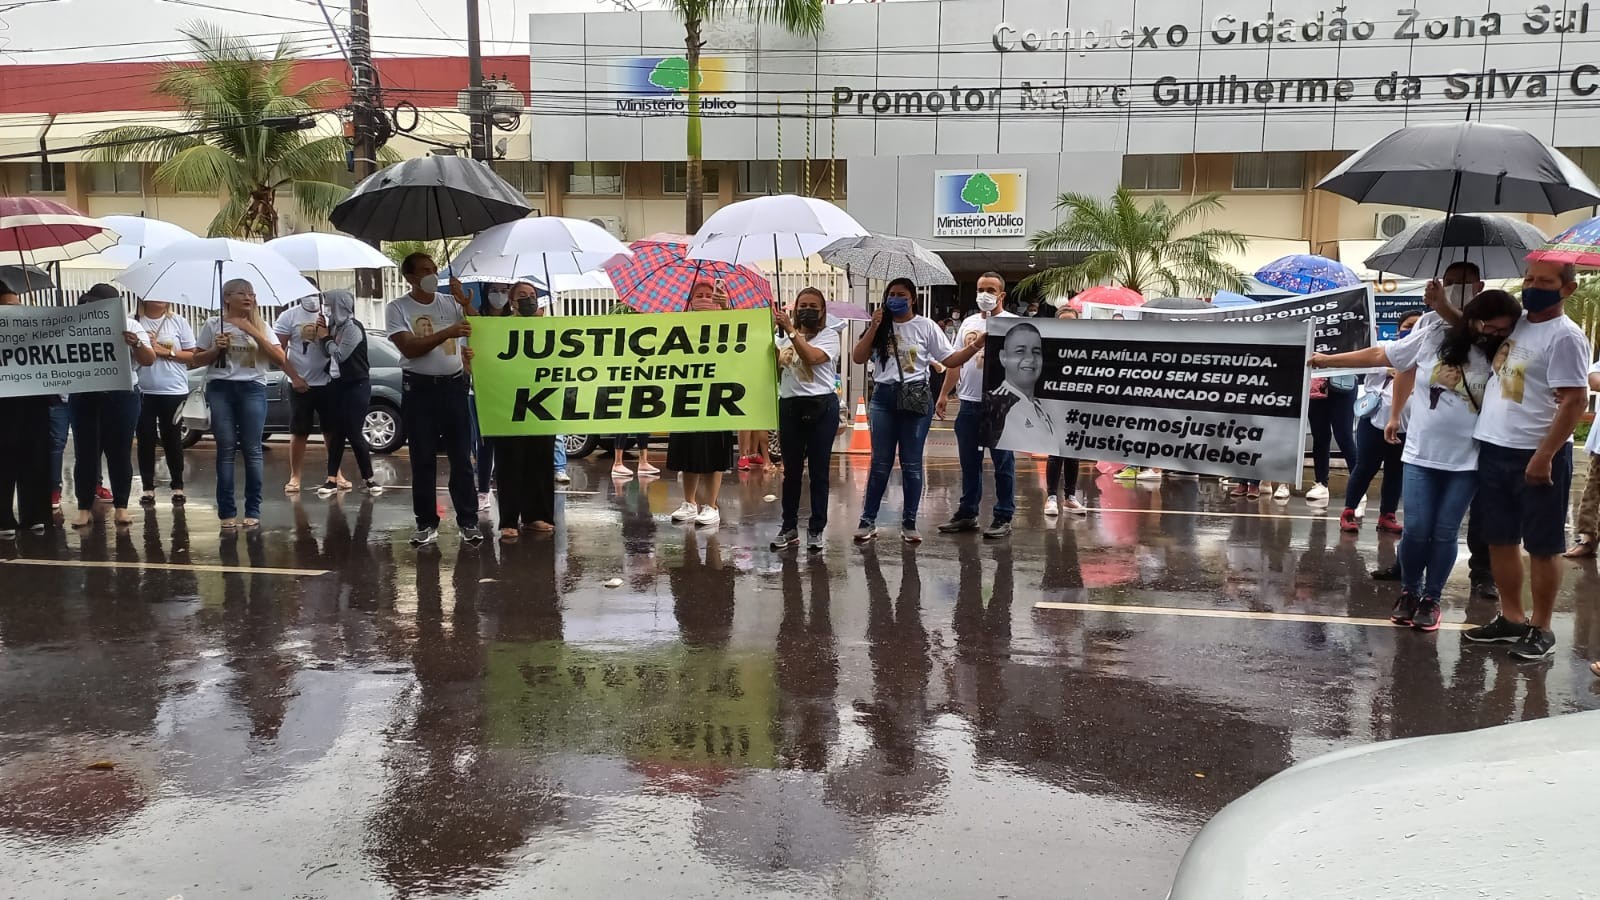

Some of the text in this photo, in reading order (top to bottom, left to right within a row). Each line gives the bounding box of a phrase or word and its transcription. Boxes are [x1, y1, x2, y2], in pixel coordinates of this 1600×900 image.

[992, 2, 1589, 57] Complexo Cidadão Zona Sul
[833, 85, 1001, 114] Promotor
[1153, 75, 1354, 106] Guilherme
[1374, 70, 1422, 101] da
[1444, 68, 1547, 100] Silva
[616, 97, 737, 111] Ministério úblico
[937, 213, 1024, 228] Ministério Público
[12, 318, 39, 328] mais
[79, 309, 110, 323] juntos
[32, 326, 65, 340] Kleber
[497, 323, 748, 363] JUSTIÇA!!!
[0, 342, 117, 367] PORKLEBER
[1058, 348, 1278, 368] UMA FAMÍLIA FOI DESTRUÍDA.
[0, 367, 118, 382] migos da Biologia 2000
[535, 363, 716, 382] PELO TENENTE
[1062, 365, 1269, 387] O FILHO FICOU SEM SEU PAI.
[42, 380, 72, 388] UNIFAP
[1043, 380, 1293, 407] KLEBER FOI ARRANCADO DE NÓS!
[511, 382, 746, 421] KLEBER
[1065, 408, 1264, 445] #queremosjustiça
[1065, 431, 1262, 467] #justiçaporKleber
